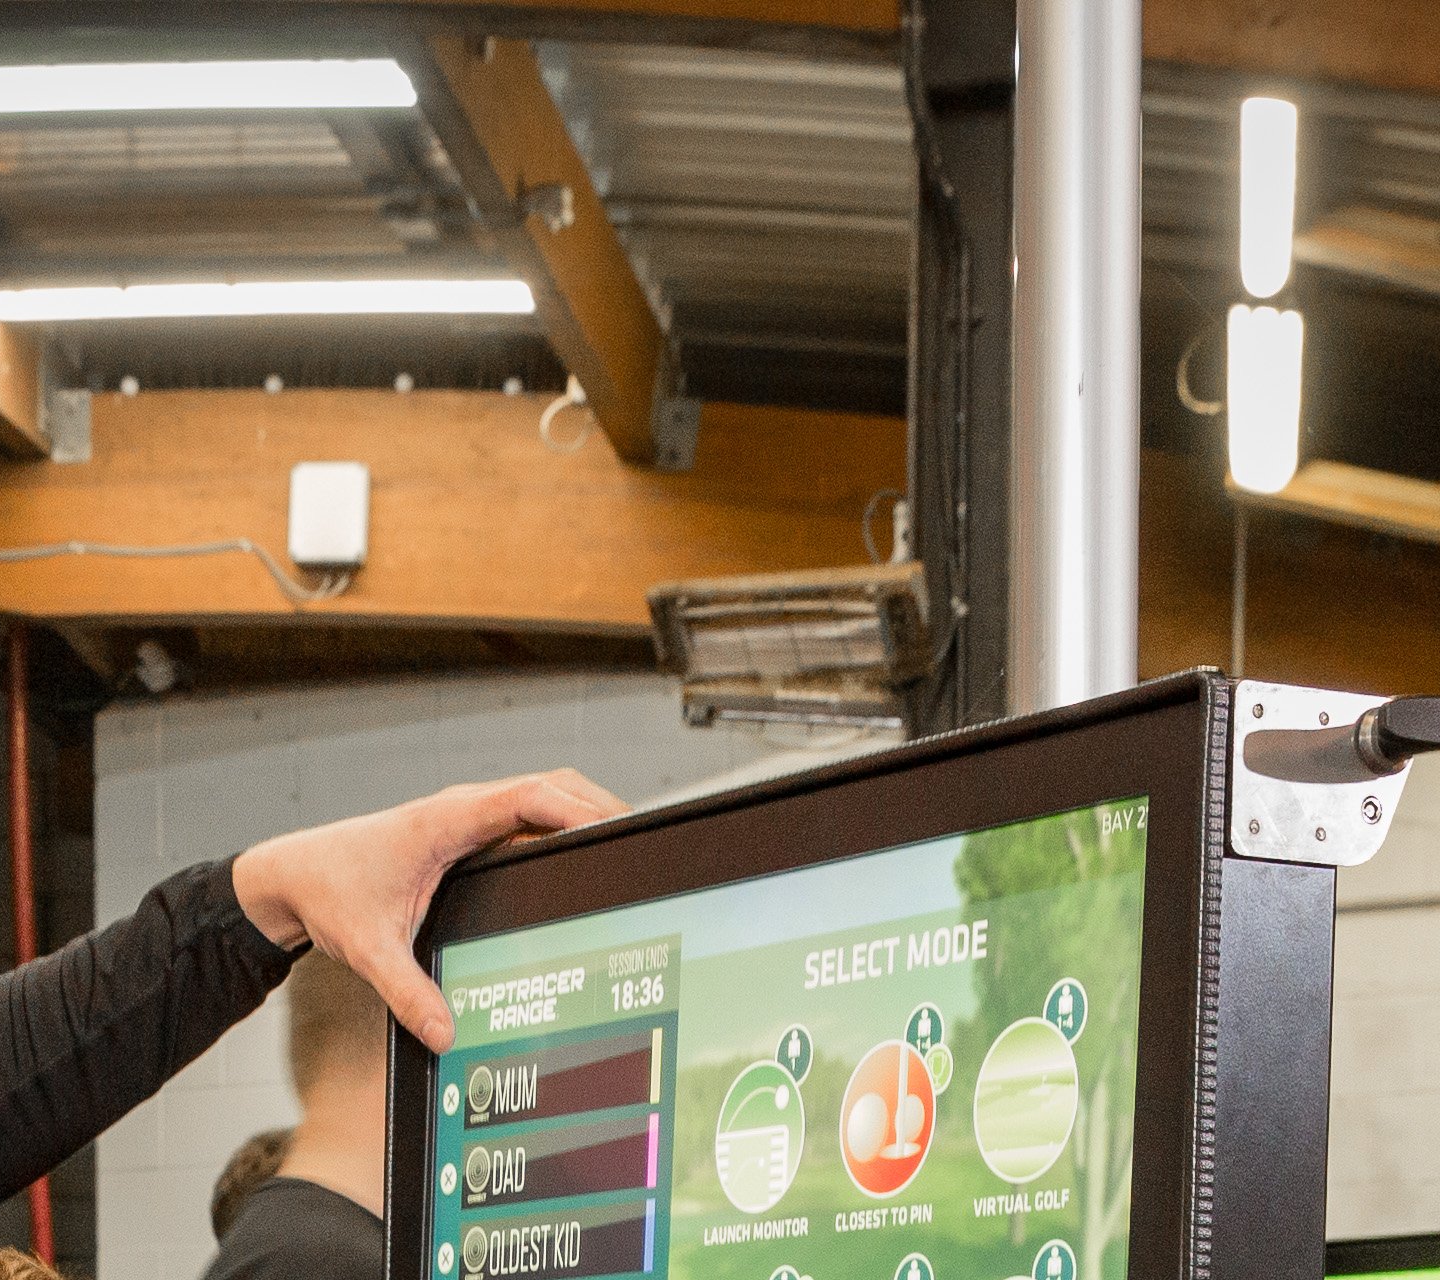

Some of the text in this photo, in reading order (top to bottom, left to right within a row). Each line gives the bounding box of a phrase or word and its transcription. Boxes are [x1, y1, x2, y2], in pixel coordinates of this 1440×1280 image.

[1101, 809, 1134, 835] BAY
[608, 943, 669, 979] SESSION ENDS
[804, 919, 988, 990] SELECT MODE
[468, 966, 586, 1012] TOPTRACER
[611, 974, 665, 1013] 18:36
[489, 997, 557, 1032] RANGE
[494, 1063, 538, 1115] MUM
[492, 1146, 526, 1196] DAD
[834, 1203, 933, 1233] CLOSEST TO PIN
[973, 1188, 1070, 1218] VIRTUAL GOLF
[489, 1220, 581, 1276] OLDEST KID
[703, 1217, 809, 1247] LAUNCH MONITOR
